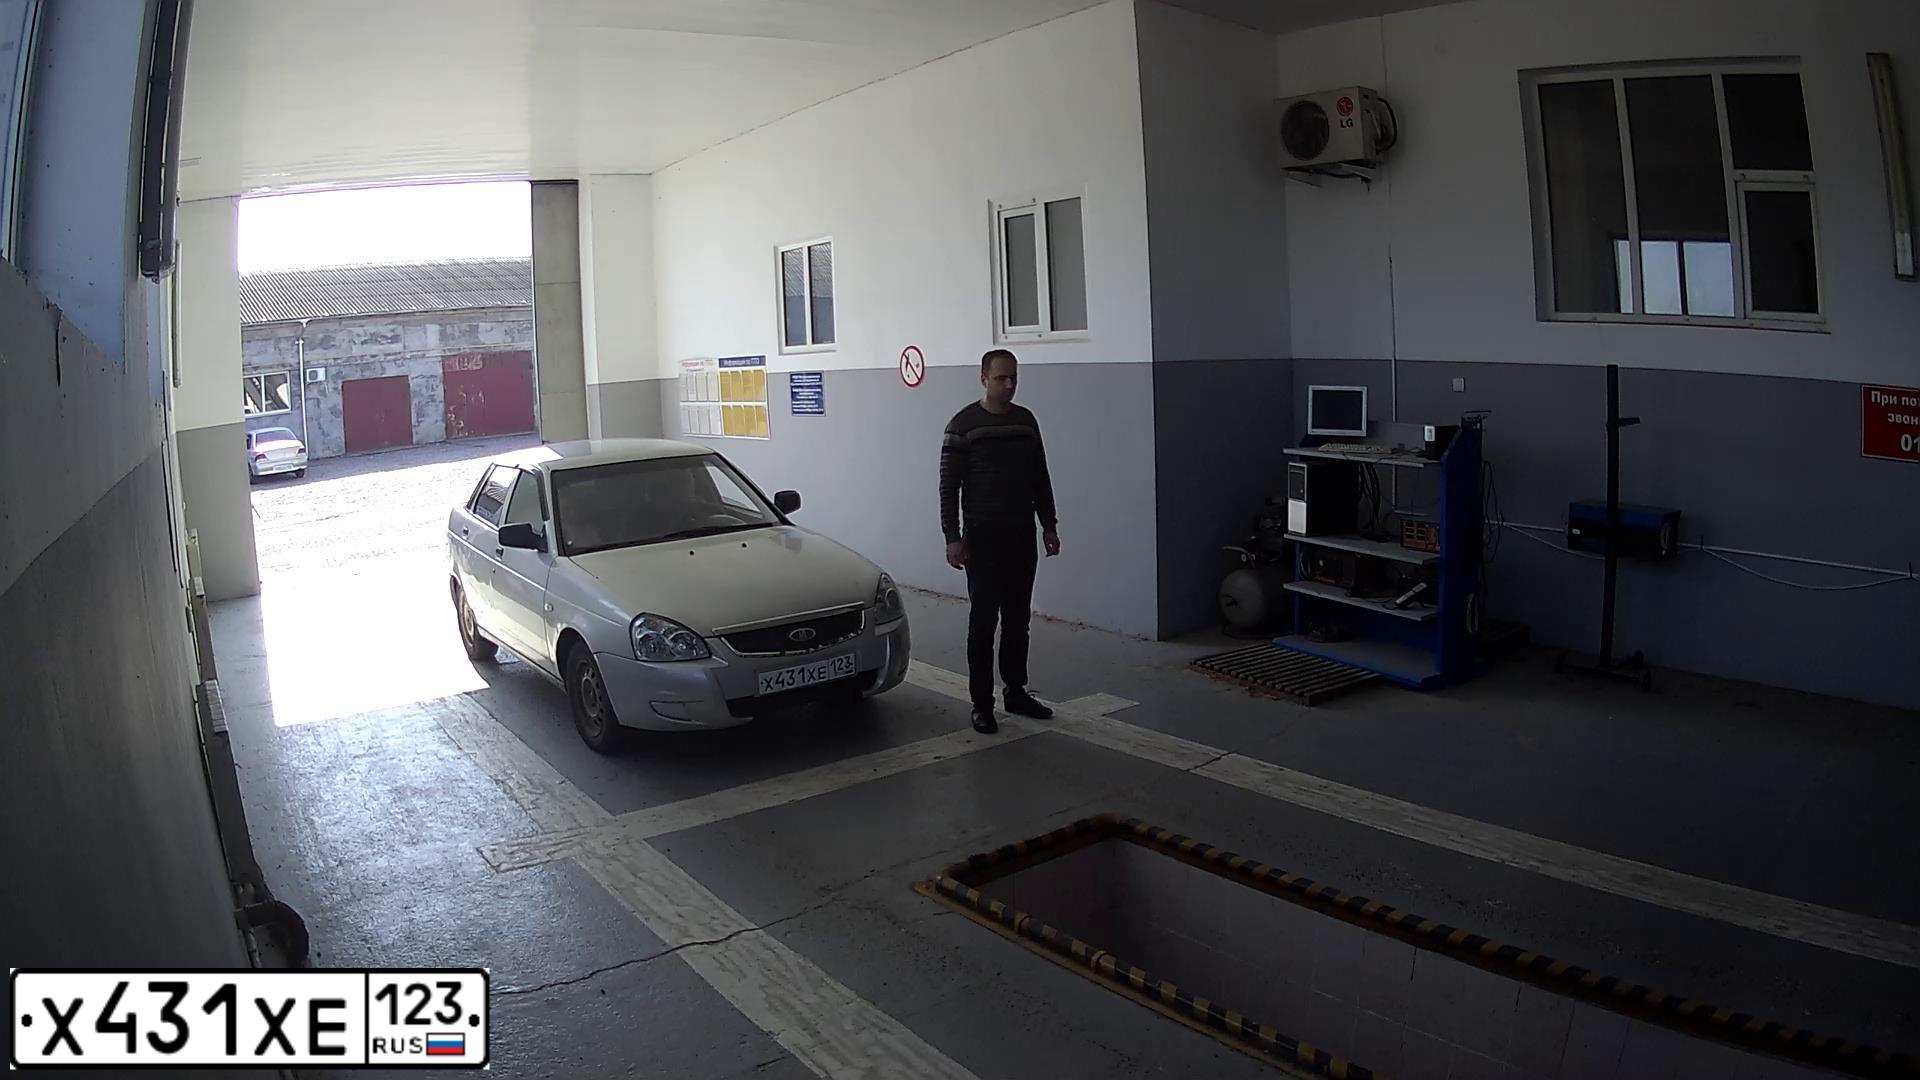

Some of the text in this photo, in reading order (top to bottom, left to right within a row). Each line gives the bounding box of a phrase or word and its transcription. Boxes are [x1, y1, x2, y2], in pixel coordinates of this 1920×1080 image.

[1340, 118, 1354, 129] LG
[1871, 390, 1920, 407] При по
[1887, 413, 1920, 425] звон
[830, 655, 851, 672] 123
